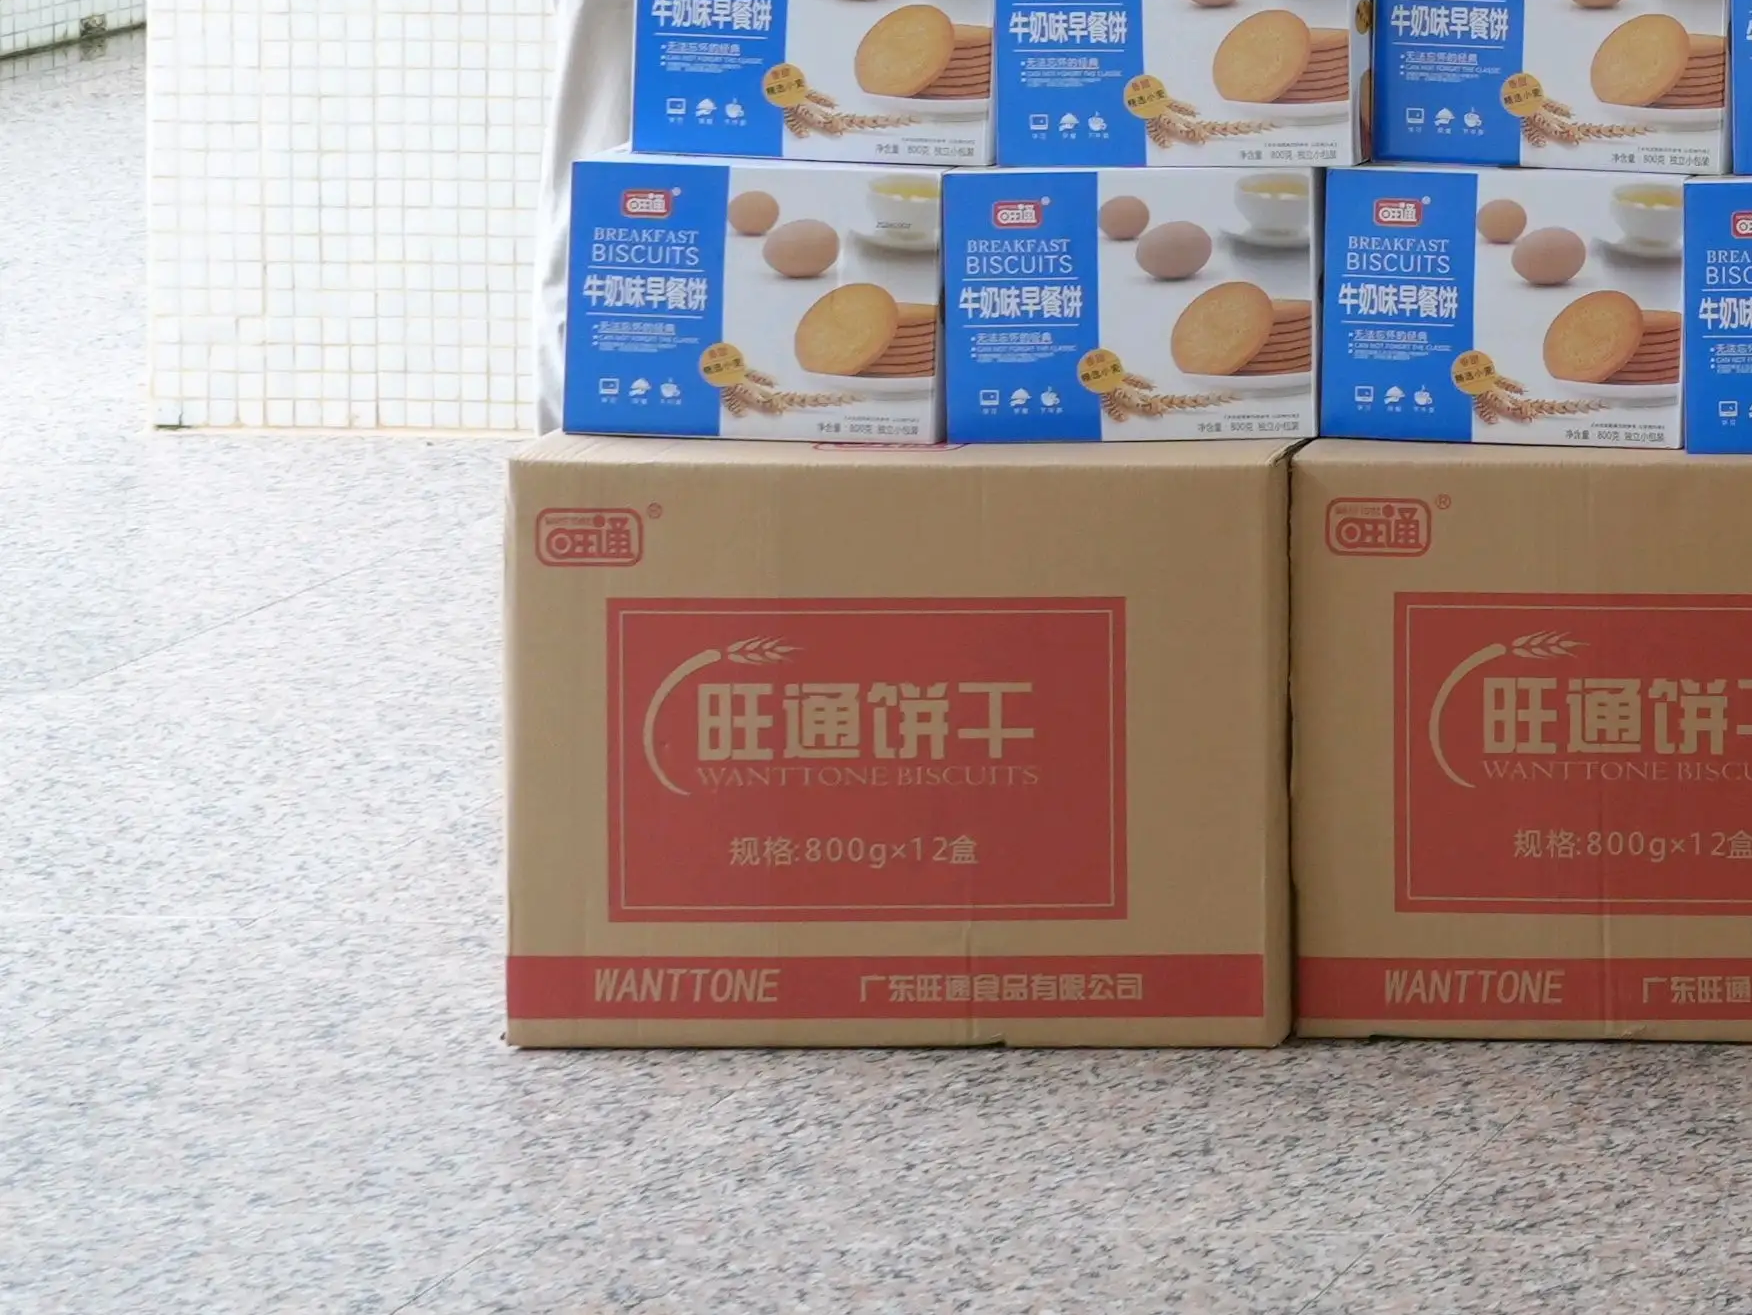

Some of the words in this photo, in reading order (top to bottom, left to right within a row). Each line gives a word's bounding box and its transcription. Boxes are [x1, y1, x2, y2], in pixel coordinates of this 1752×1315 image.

[1009, 10, 1128, 45] 牛奶味早餐饼
[1391, 5, 1509, 41] 牛奶味早餐饼
[593, 227, 699, 245] BREAKFAST
[966, 238, 1070, 256] BREAKFAST
[1347, 236, 1449, 254] BREAKFAST
[592, 244, 700, 265] BISCUITS
[966, 255, 1073, 276] BISCUITS
[1346, 253, 1450, 274] BISCUITS
[583, 274, 708, 311] 牛奶味早餐饼
[959, 285, 1083, 321] 牛奶味早餐饼
[1338, 283, 1459, 319] 牛奶味早餐饼
[698, 682, 1034, 760] 旺通饼干
[698, 766, 889, 786] WANTTONE
[898, 766, 1038, 786] BISCUITS
[1484, 762, 1670, 782] WANTTONE
[594, 969, 781, 1003] WANTTONE
[860, 974, 1144, 1002] 广东旺通食品有限公司
[1383, 970, 1566, 1005] WANTTONE
